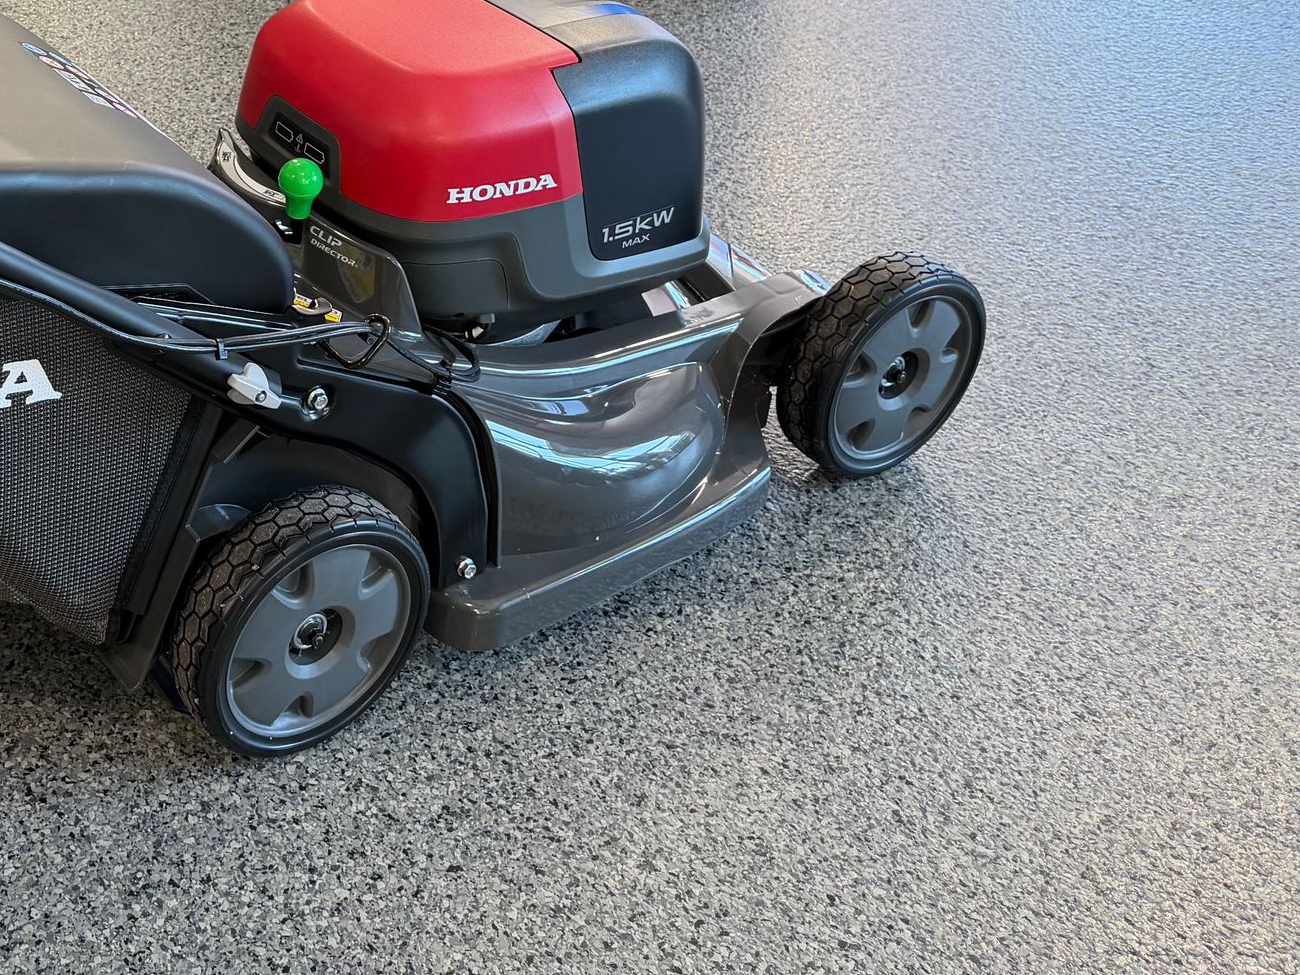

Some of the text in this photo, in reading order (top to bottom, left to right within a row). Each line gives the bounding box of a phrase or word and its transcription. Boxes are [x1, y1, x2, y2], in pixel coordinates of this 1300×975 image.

[446, 174, 558, 205] HONDA
[309, 224, 344, 248] CLIP
[602, 206, 676, 244] 1.5kW
[310, 237, 357, 268] DIRECTOR
[622, 233, 651, 249] MAX
